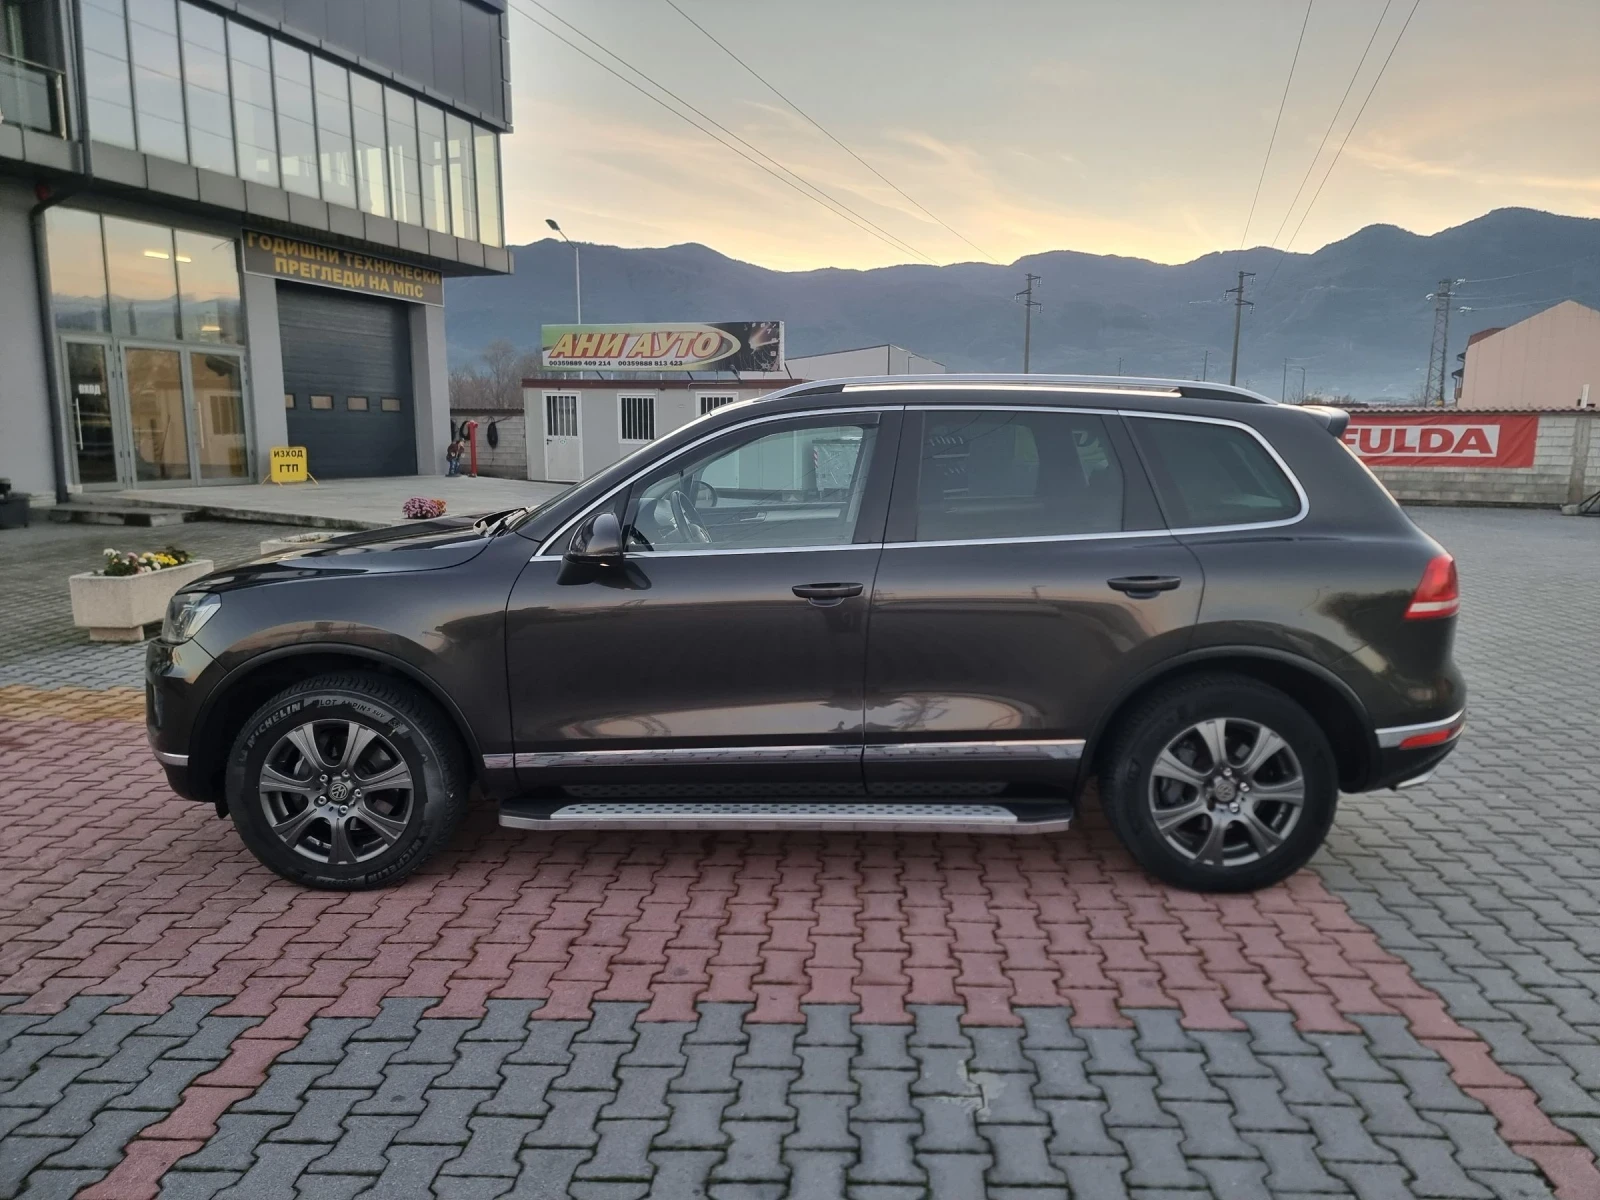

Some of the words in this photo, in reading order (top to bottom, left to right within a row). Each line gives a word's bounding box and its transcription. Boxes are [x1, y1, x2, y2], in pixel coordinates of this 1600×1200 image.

[248, 232, 340, 264] ГОДИШНИ
[344, 253, 440, 285] ТЕХНИЧЕСКИ
[275, 257, 365, 288] ПРЕГЛЕДИ
[370, 276, 390, 292] НА
[393, 282, 424, 298] МПС
[549, 332, 628, 359] АНИ
[627, 331, 724, 359] АУТО
[274, 450, 303, 458] ИЗХОД
[1340, 428, 1493, 454] FULDA
[280, 464, 298, 473] ГТП
[247, 702, 300, 748] MICHELIN
[367, 838, 423, 883] MICHELIN
